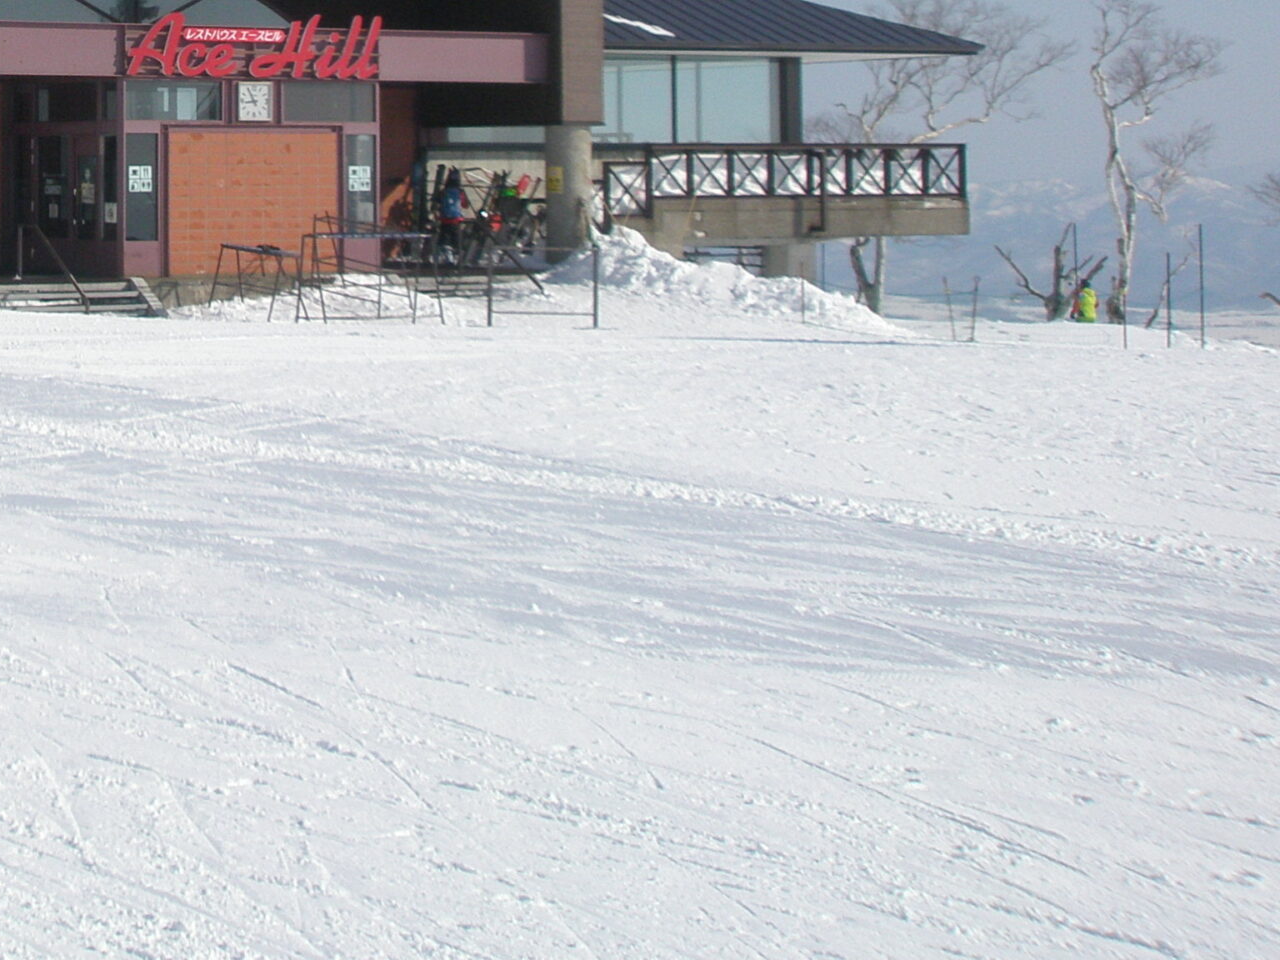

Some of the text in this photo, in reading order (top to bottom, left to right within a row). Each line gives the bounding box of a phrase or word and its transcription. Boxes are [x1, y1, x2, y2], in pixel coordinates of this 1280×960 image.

[127, 12, 383, 79] Ace Hill
[185, 28, 282, 42] レストハウス エースヒル
